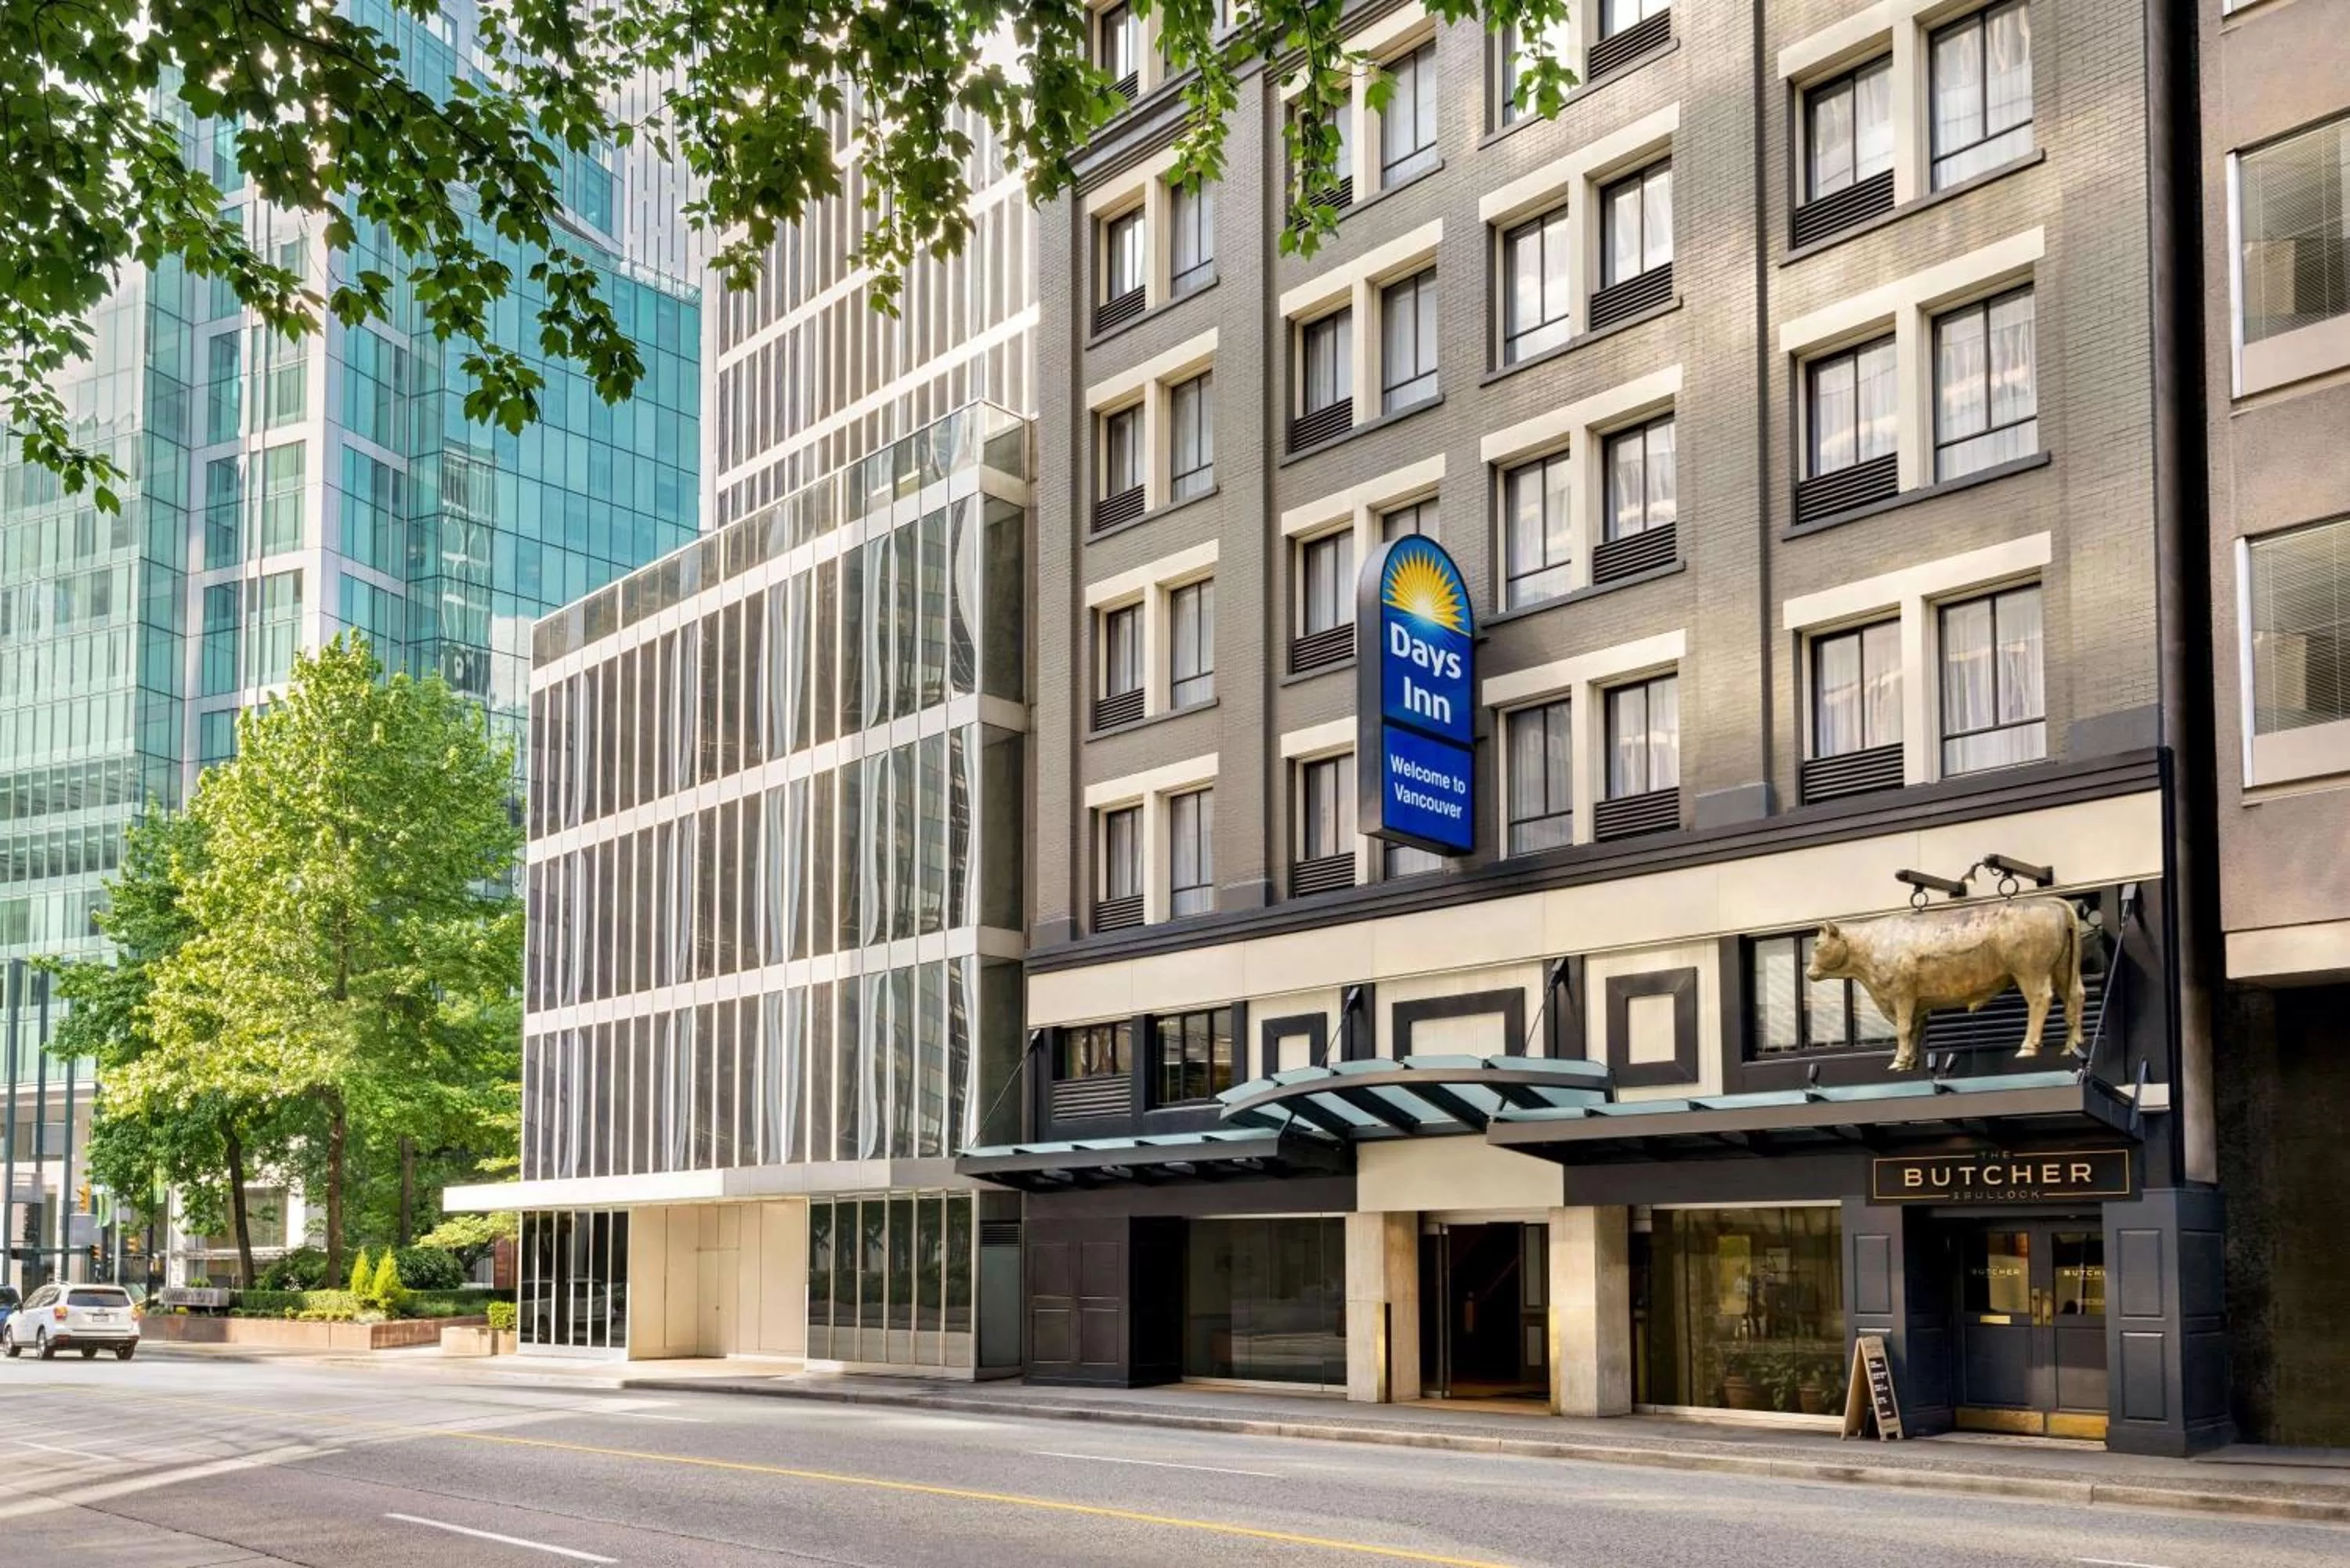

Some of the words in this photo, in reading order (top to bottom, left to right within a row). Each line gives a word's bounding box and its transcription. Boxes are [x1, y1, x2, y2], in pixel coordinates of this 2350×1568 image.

[1390, 621, 1461, 679] Days
[1404, 675, 1452, 724] Inn
[1390, 753, 1450, 789] Welcome
[1452, 775, 1466, 794] to
[1394, 782, 1462, 819] Vancouver
[1904, 1163, 2092, 1187] BUTCHER
[1979, 1151, 2011, 1160] THE
